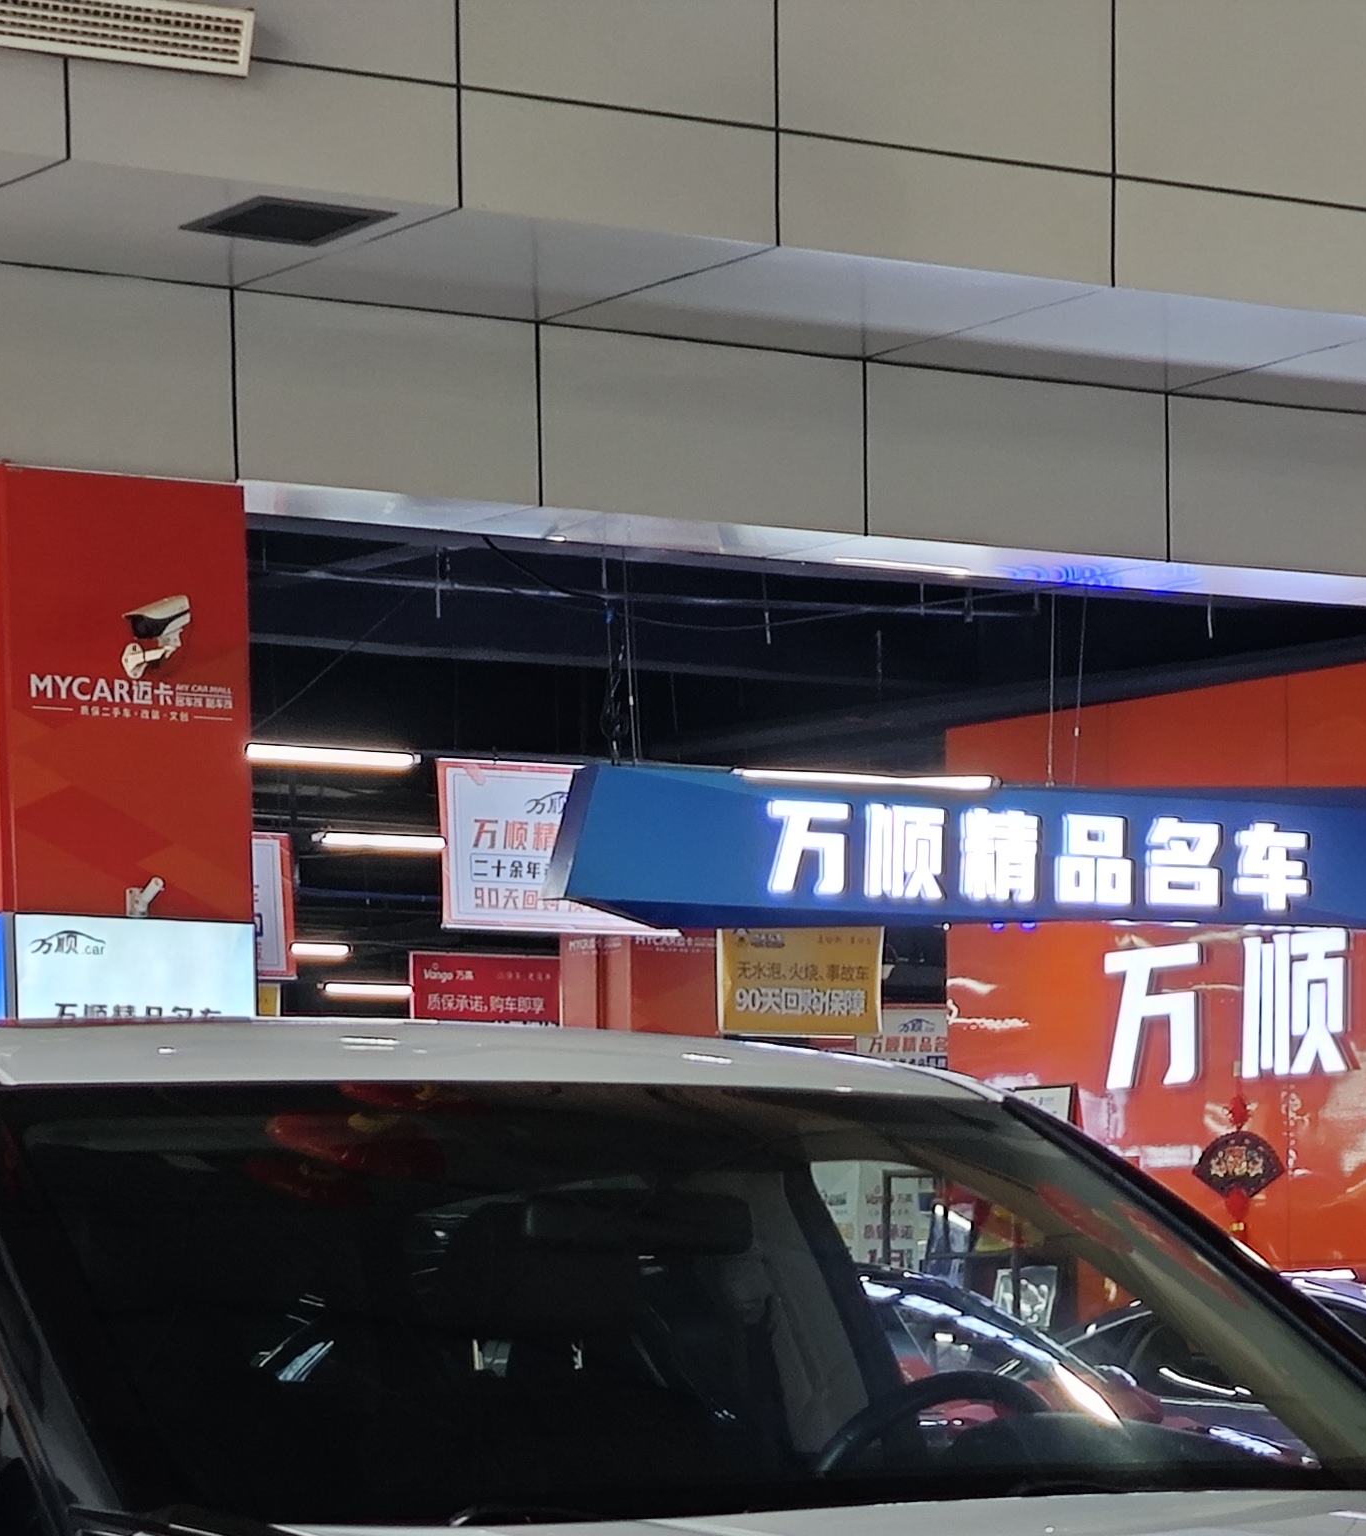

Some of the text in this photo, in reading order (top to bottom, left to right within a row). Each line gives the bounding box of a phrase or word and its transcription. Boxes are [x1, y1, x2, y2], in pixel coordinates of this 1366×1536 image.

[474, 860, 549, 879] 二十余年
[766, 800, 1311, 911] 万顺精品名车
[735, 986, 867, 1016] 90天回购保障
